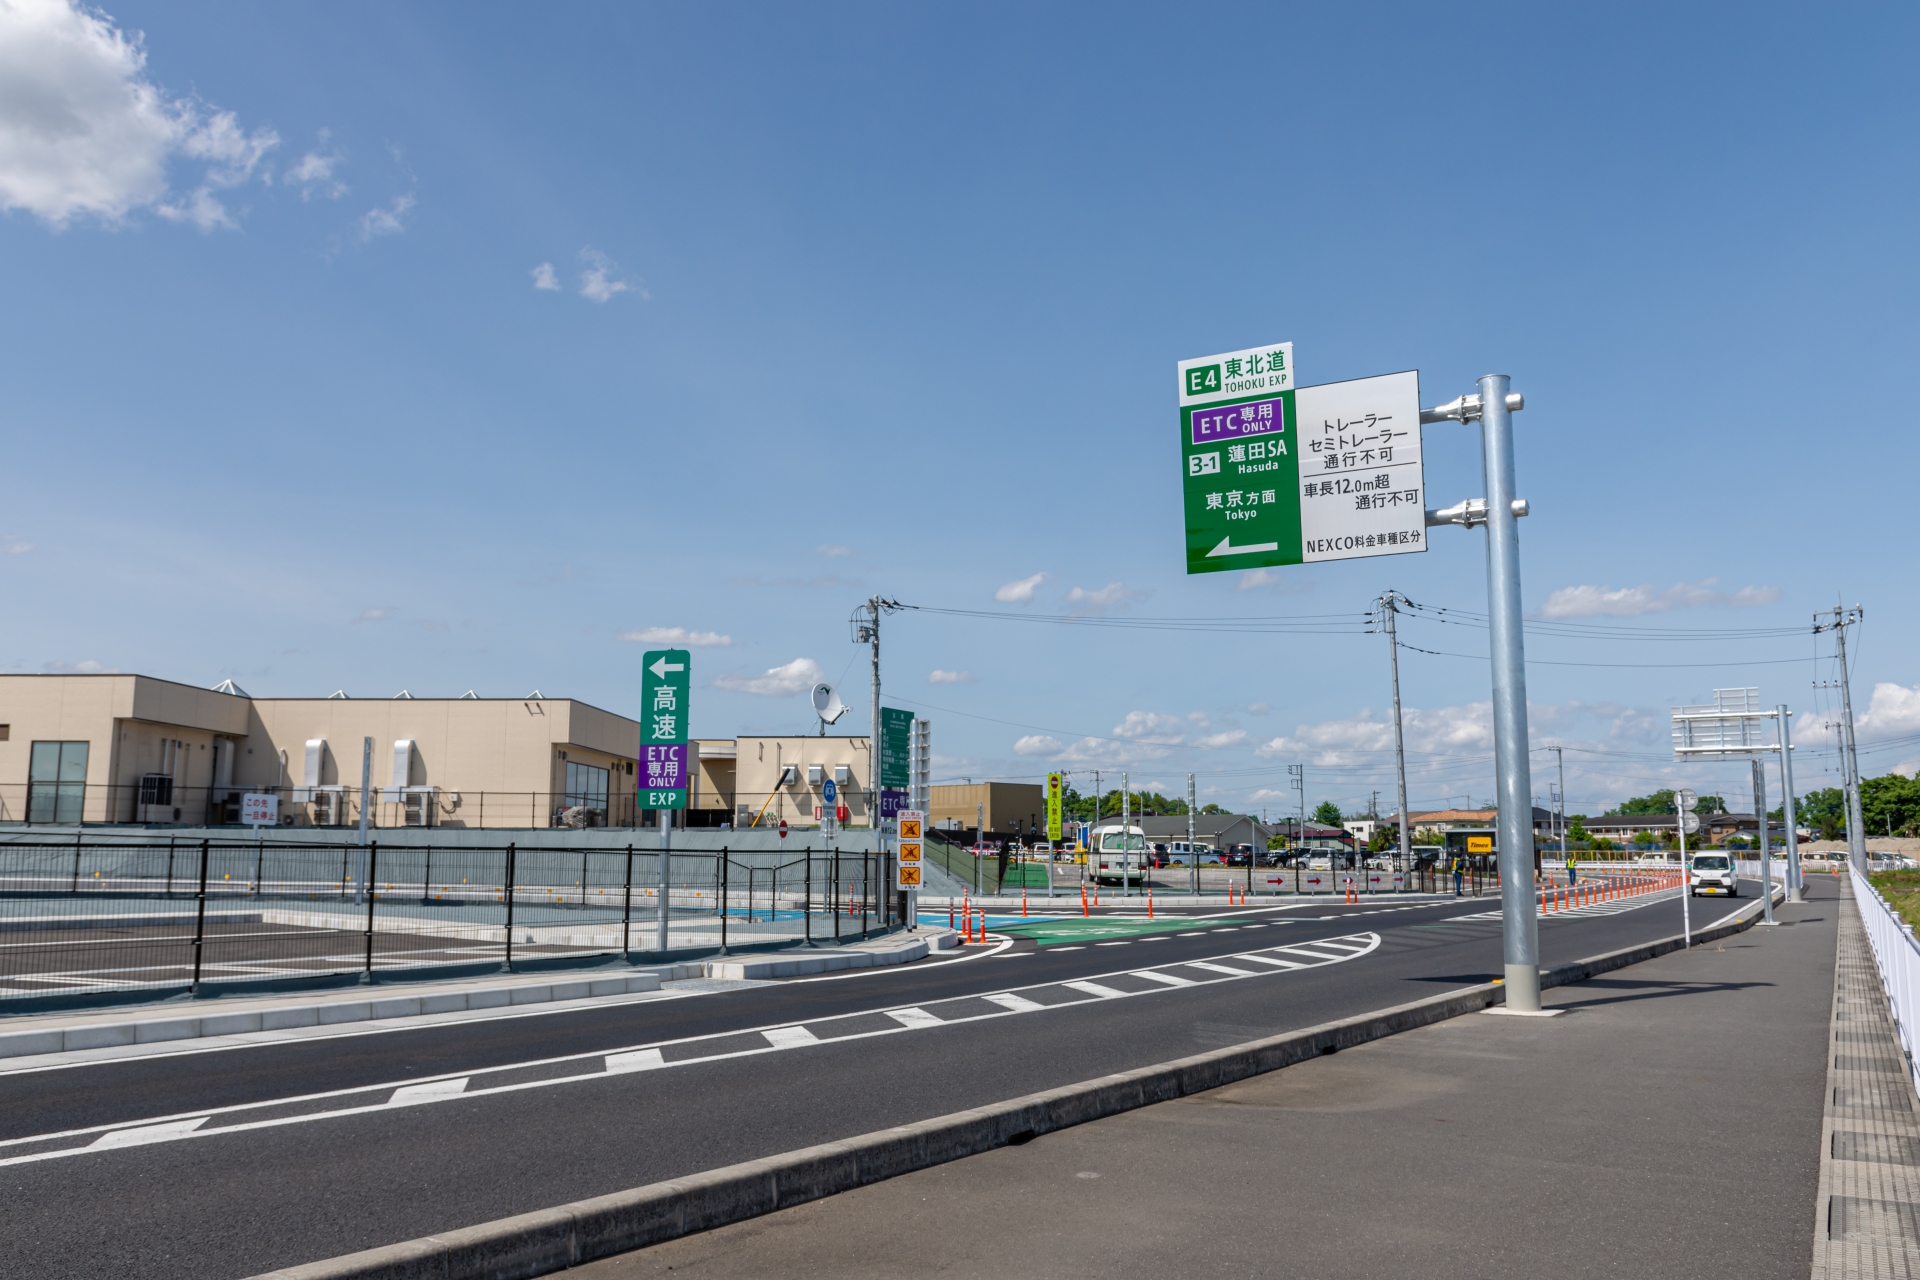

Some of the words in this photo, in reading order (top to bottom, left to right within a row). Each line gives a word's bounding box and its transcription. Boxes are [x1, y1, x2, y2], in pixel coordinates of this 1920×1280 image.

[1224, 350, 1286, 379] 東北道
[1191, 369, 1217, 391] E4
[1224, 377, 1265, 393] TOHOKU
[1269, 374, 1287, 387] EXP
[1201, 413, 1237, 434] ETC
[1240, 403, 1273, 421] 専用
[1242, 420, 1272, 433] ONLY
[1324, 413, 1393, 434] トレーラー
[1308, 428, 1408, 453] セミトレーラー
[1191, 456, 1216, 473] 3-1
[1228, 439, 1288, 463] 蓮田SA
[1324, 446, 1394, 470] 通行不可
[1238, 460, 1279, 474] Hasuda
[1303, 473, 1391, 498] 車長12.0m超
[1205, 489, 1276, 510] 東京方面
[1355, 488, 1420, 511] 通行不可
[1225, 509, 1257, 521] Tokyo
[1306, 529, 1421, 553] NEXCO料金車種区分
[652, 684, 677, 740] 高速
[647, 746, 679, 761] ETC
[647, 761, 679, 777] 専用
[648, 777, 677, 787] ONLY
[246, 798, 268, 808] この先
[649, 792, 677, 806] EXP
[882, 797, 899, 810] ETC
[244, 811, 275, 820] 一旦停止
